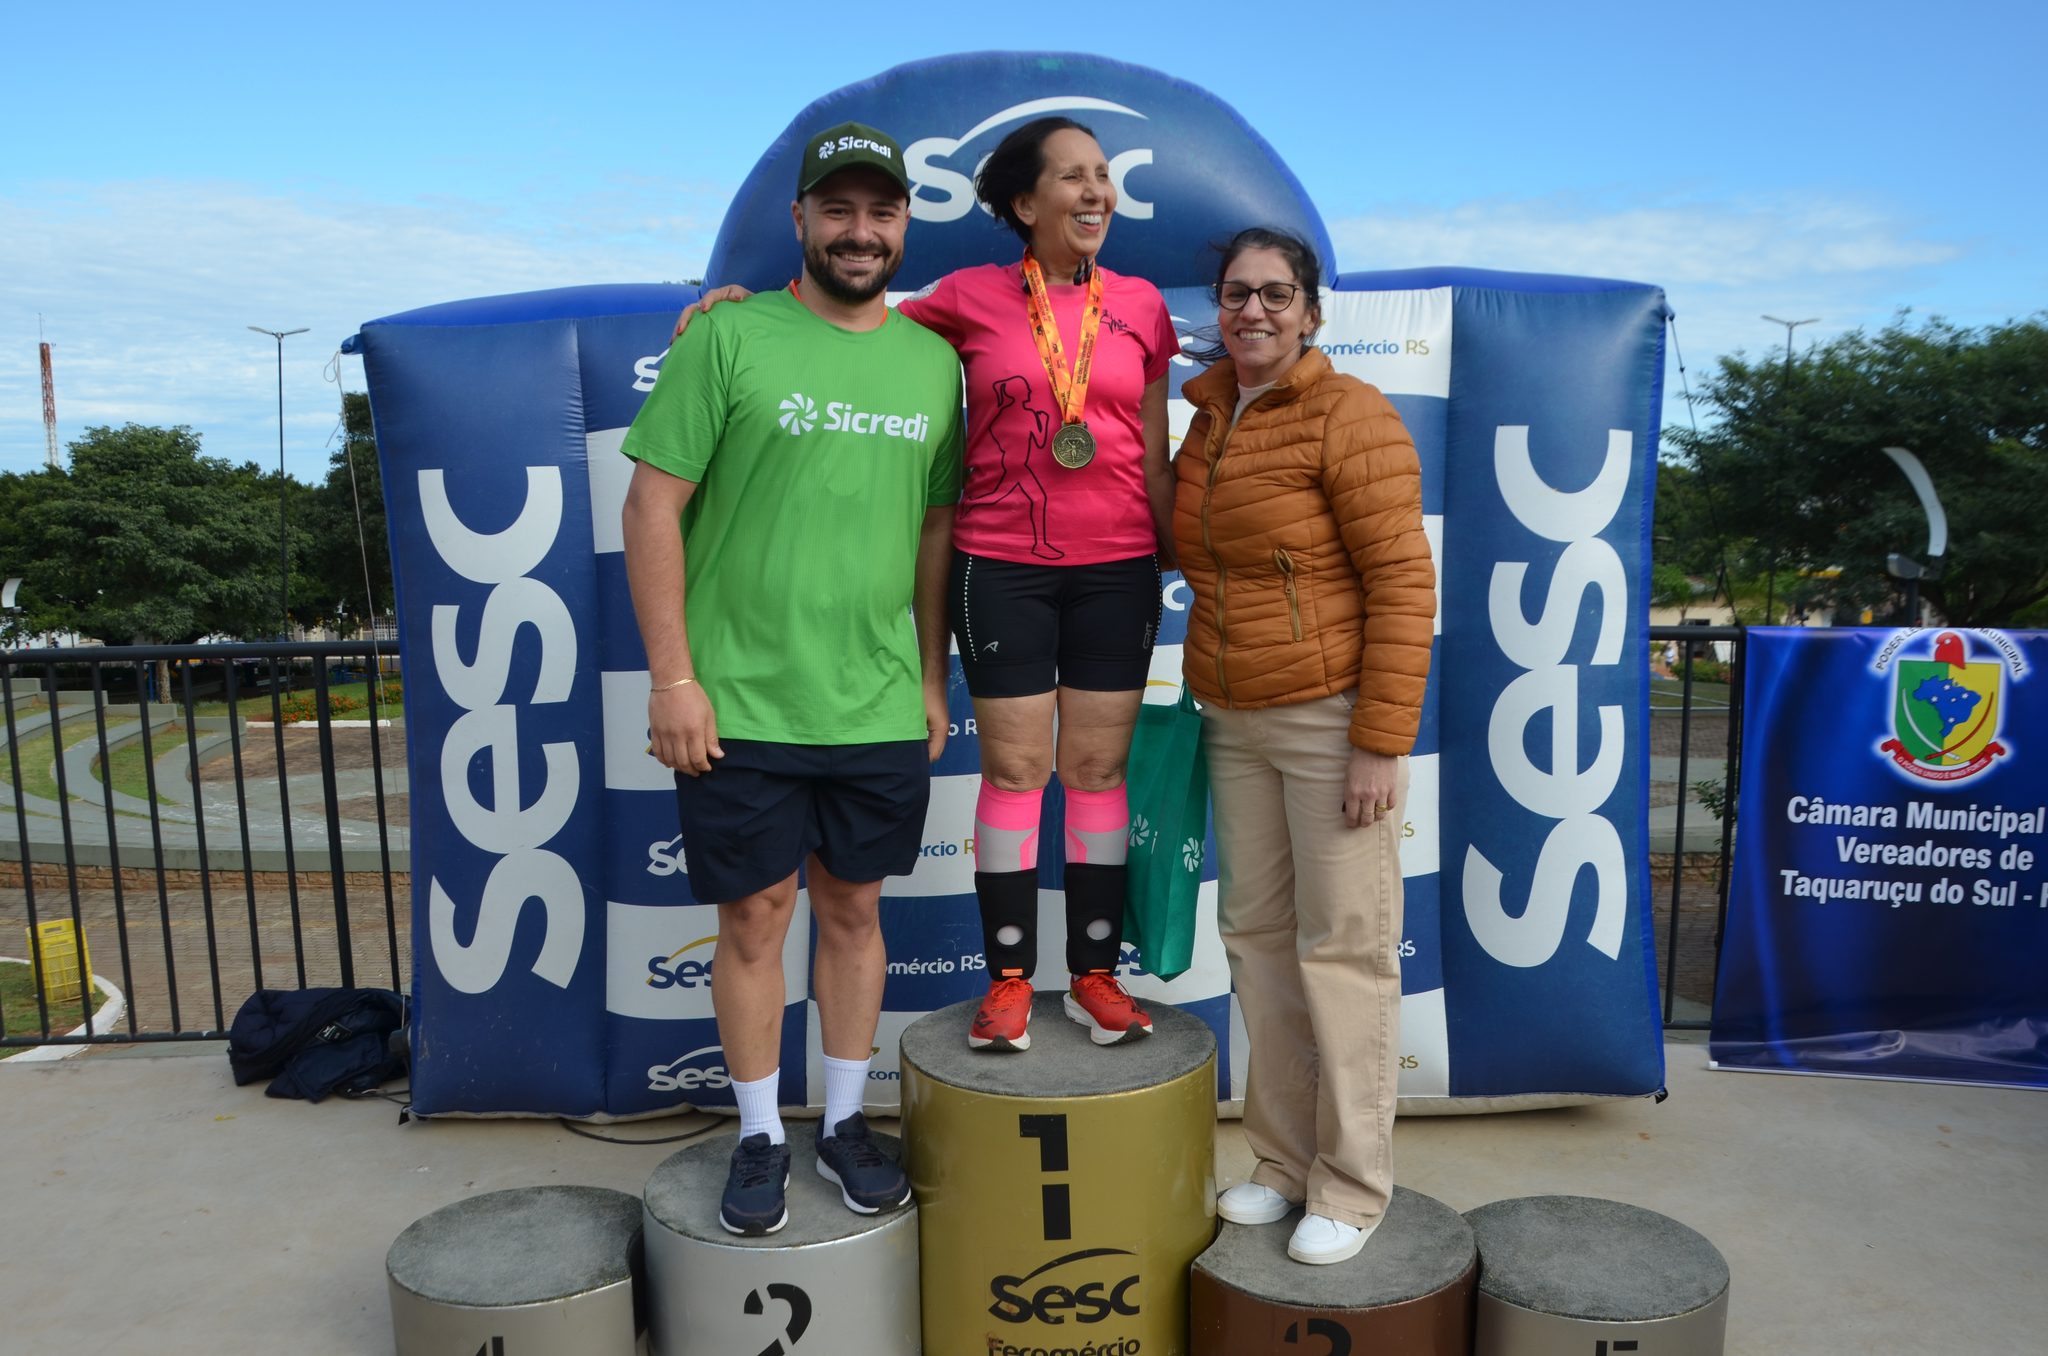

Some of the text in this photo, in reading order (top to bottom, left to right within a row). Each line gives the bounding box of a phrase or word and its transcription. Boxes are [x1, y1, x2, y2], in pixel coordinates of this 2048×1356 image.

[837, 136, 892, 159] Sicredi
[1320, 339, 1430, 355] omércio RS
[823, 401, 929, 443] Sicredi
[1875, 635, 1905, 671] PODER
[1787, 795, 2046, 839] Câmara Municipal
[1836, 836, 2034, 871] Vereadores de
[1779, 869, 1922, 908] Taquaruçu
[1930, 877, 1964, 905] do
[1972, 879, 2017, 907] Sul
[888, 953, 987, 975] mércio RS
[647, 1065, 731, 1091] Ses
[1019, 1114, 1072, 1241] 1
